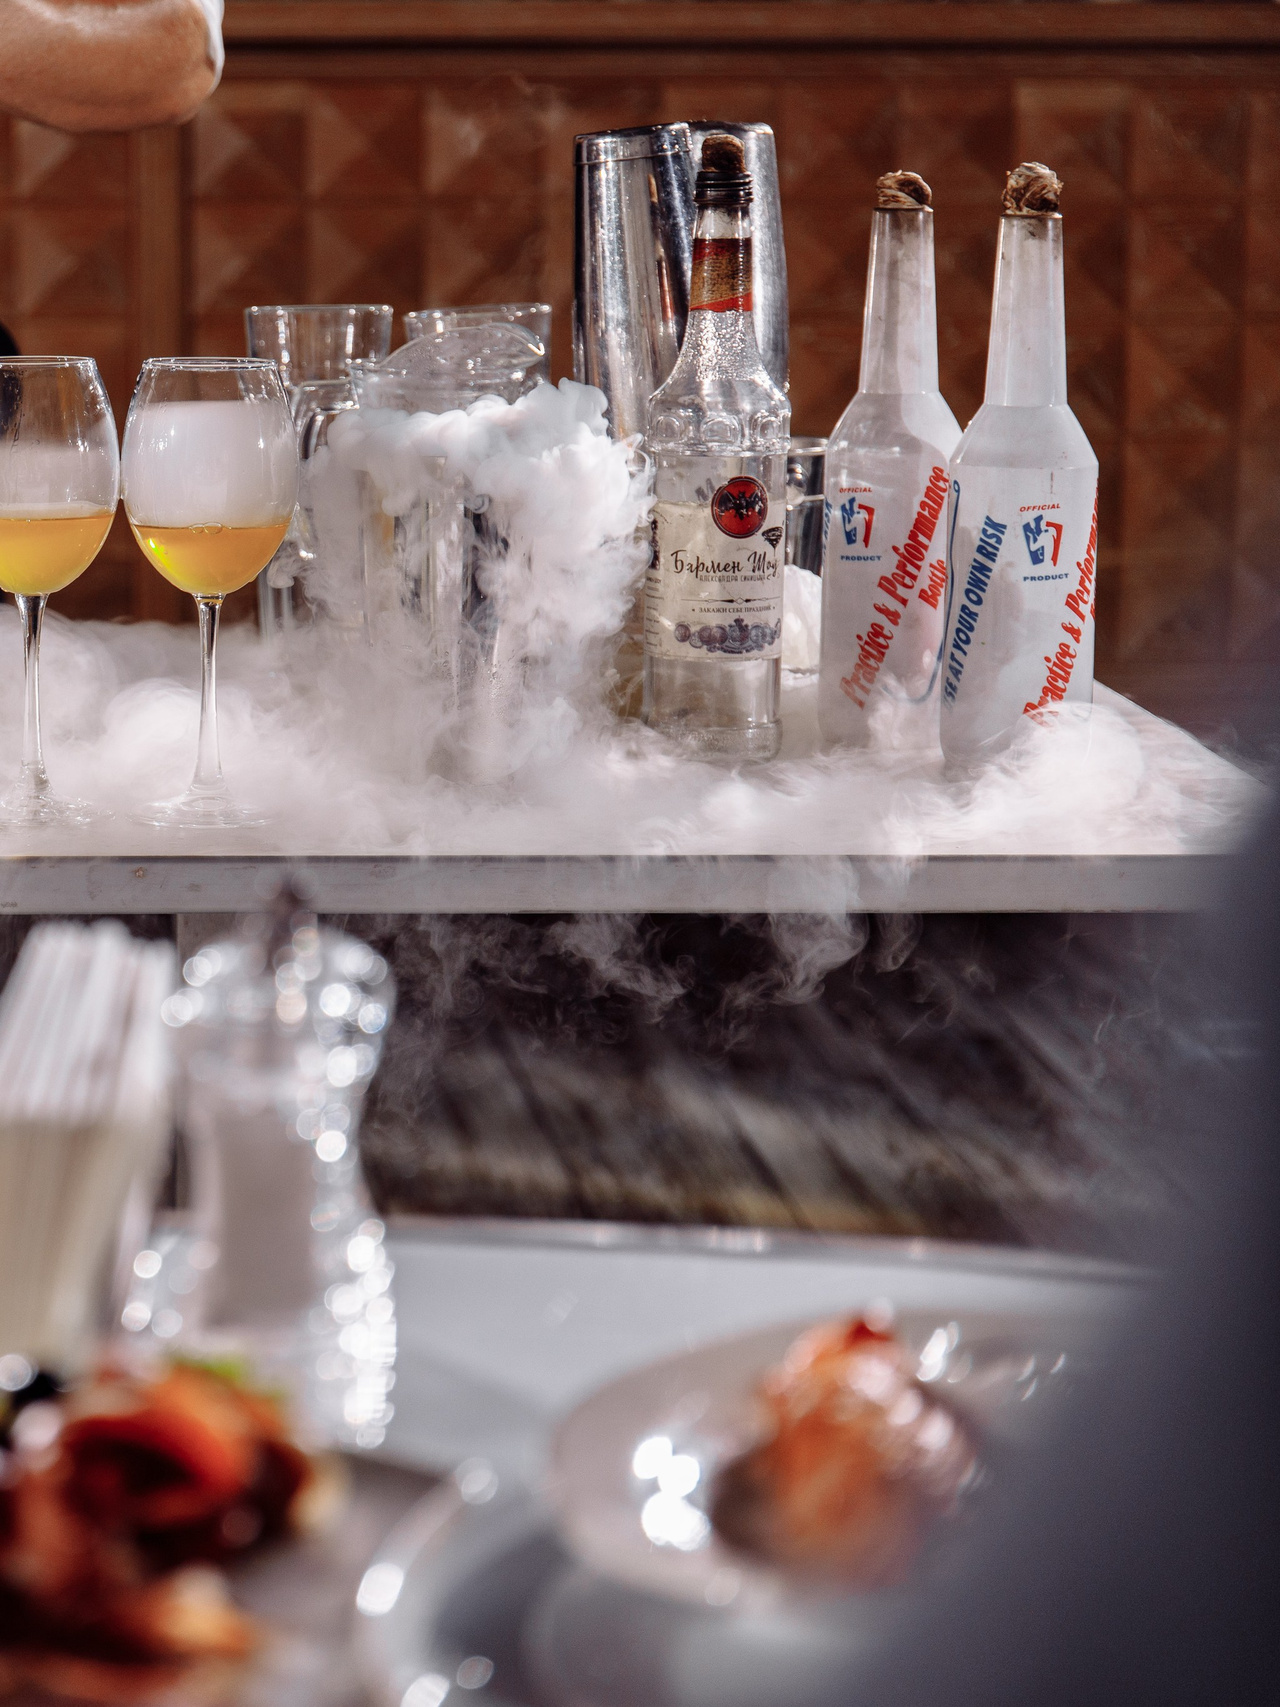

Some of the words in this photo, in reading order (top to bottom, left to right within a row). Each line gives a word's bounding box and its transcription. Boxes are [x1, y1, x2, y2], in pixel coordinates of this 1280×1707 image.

[1019, 503, 1061, 513] OFFICIAL
[877, 466, 950, 608] Performance
[976, 515, 1008, 564] RISK
[1065, 478, 1099, 624] Performa
[670, 549, 744, 579] Бармен
[964, 557, 993, 606] OWN
[1023, 573, 1069, 582] PRODUCT
[873, 602, 902, 627] &
[952, 603, 979, 657] YOUR
[1061, 621, 1082, 644] &
[838, 622, 894, 711] Practice
[948, 651, 964, 683] AT
